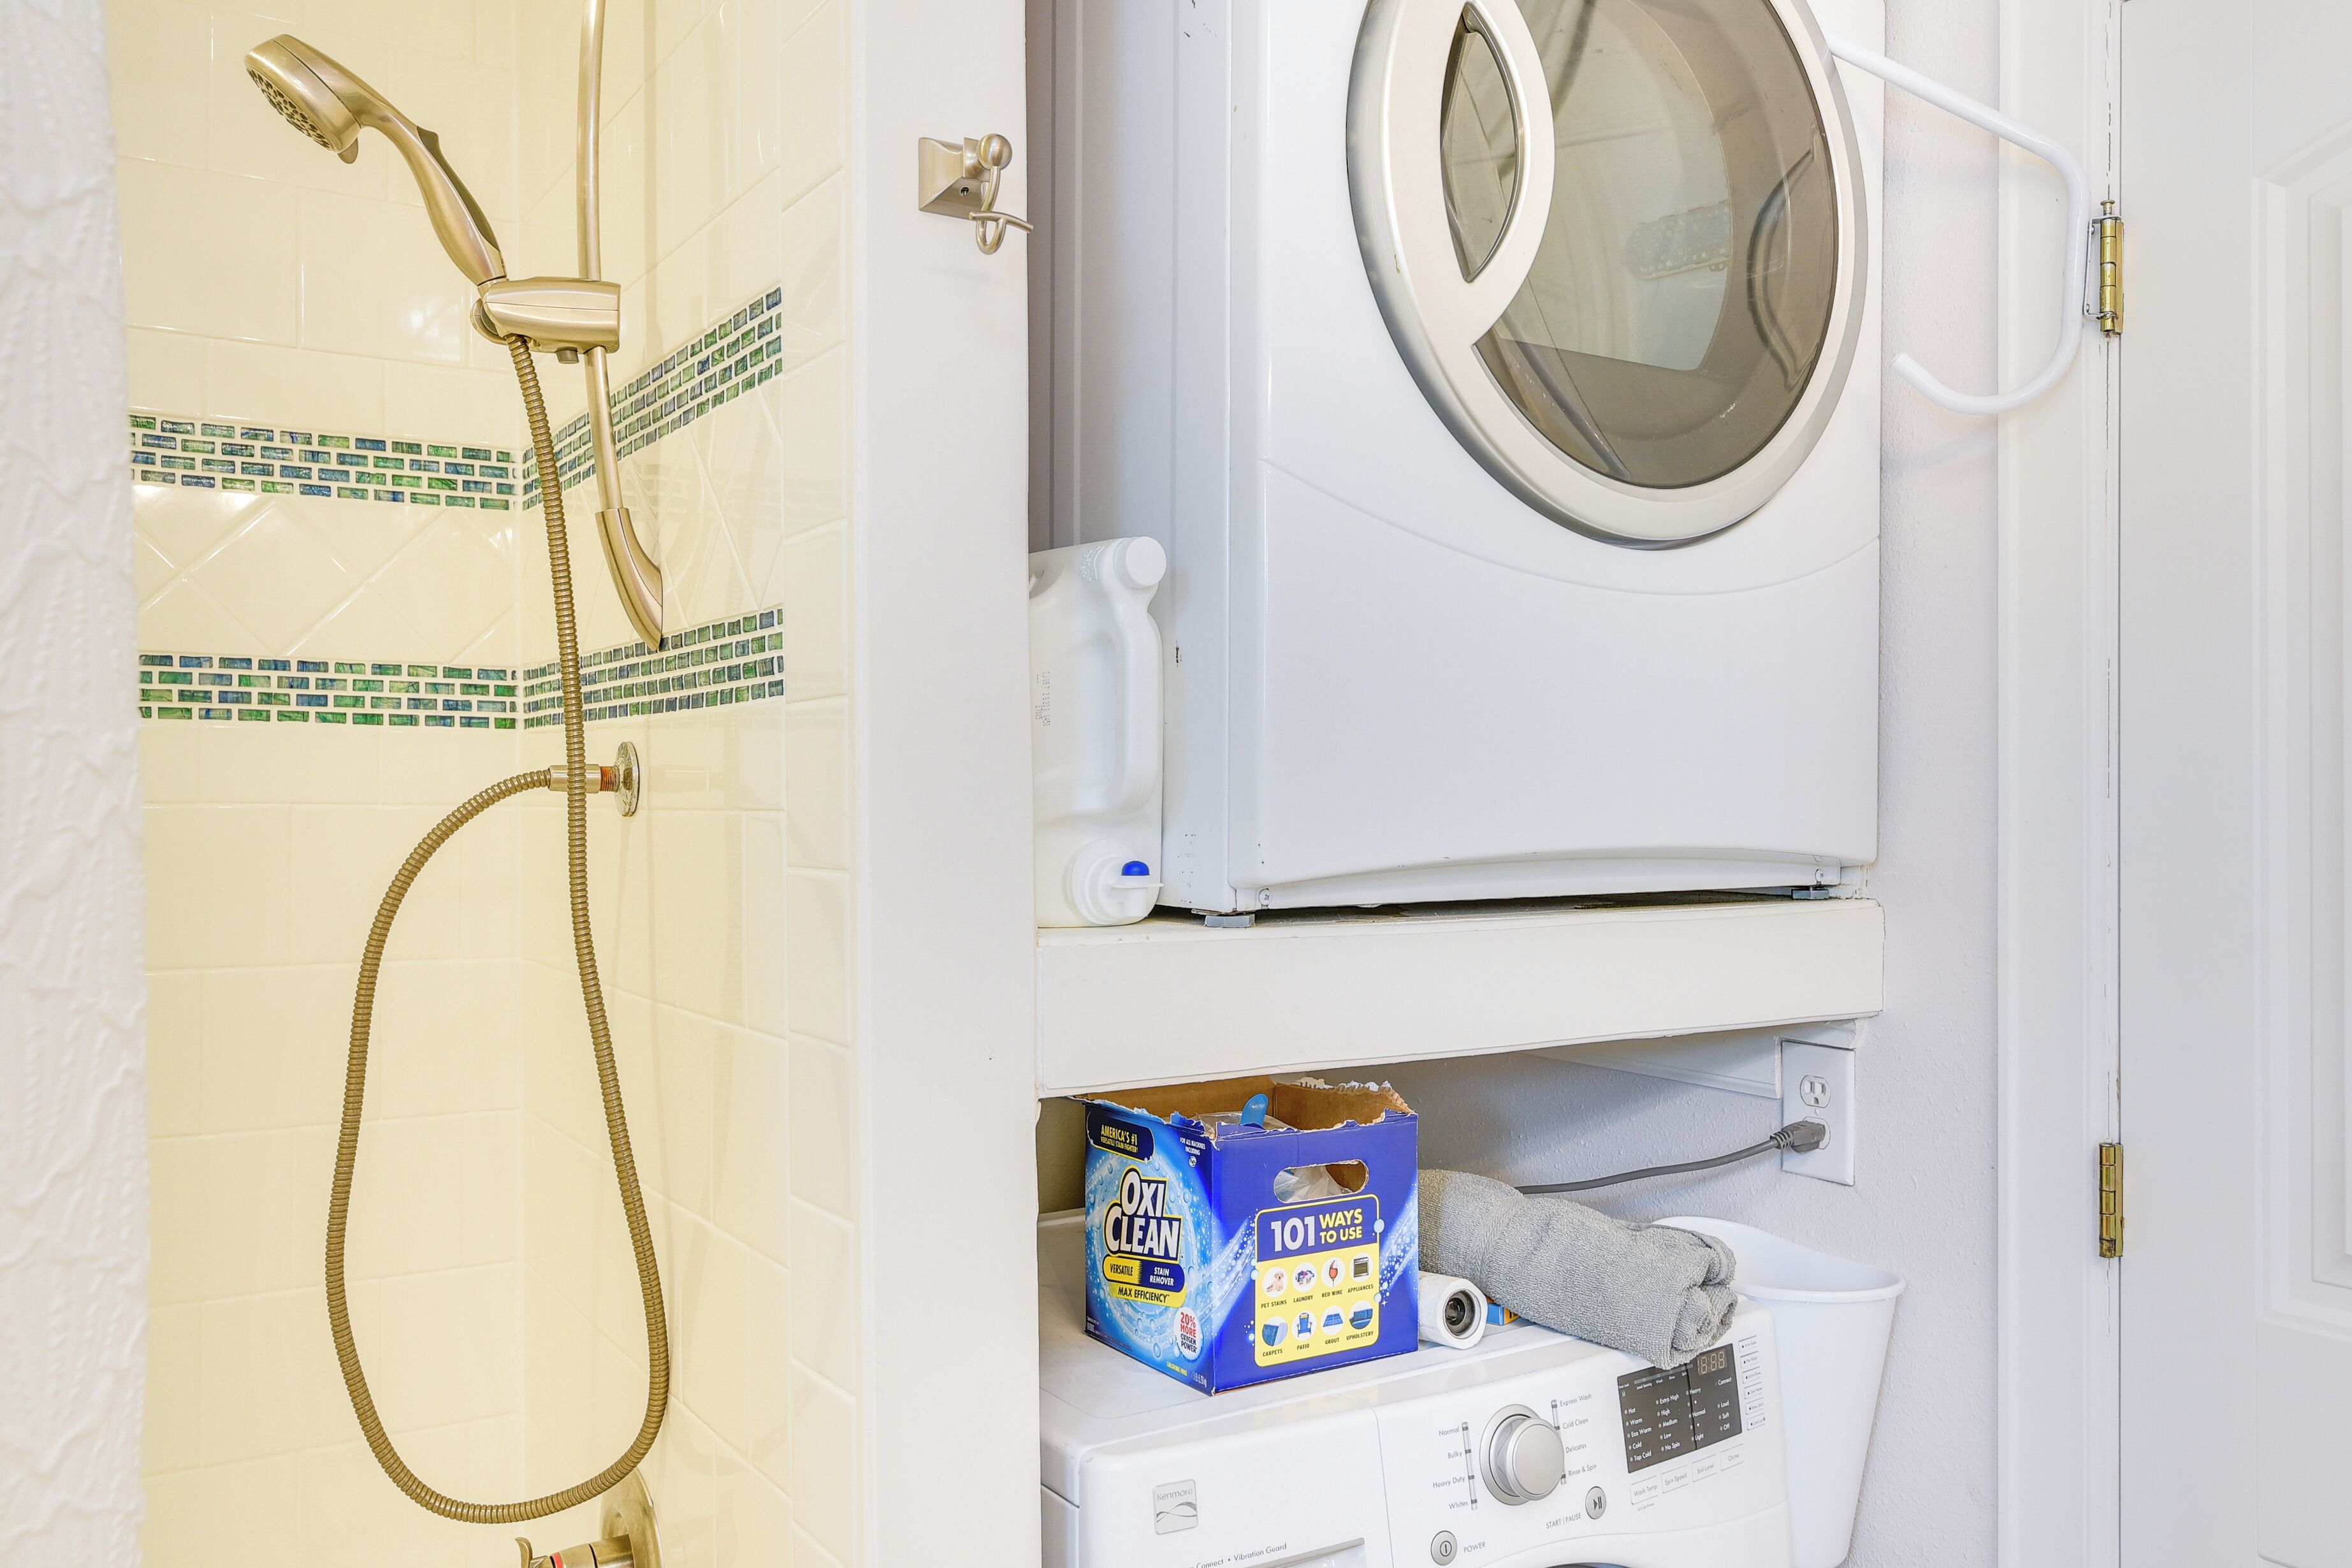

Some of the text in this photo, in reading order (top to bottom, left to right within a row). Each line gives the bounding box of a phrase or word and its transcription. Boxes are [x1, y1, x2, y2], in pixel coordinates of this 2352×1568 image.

[1101, 1124, 1138, 1146] AMERICA'S #1
[1101, 1136, 1115, 1147] VERSATILE
[1115, 1141, 1124, 1149] STAIN
[1191, 1140, 1205, 1149] MACHINES
[1186, 1146, 1200, 1156] INCLUDING
[1121, 1172, 1165, 1217] OXI
[1319, 1209, 1363, 1229] WAYS
[1105, 1205, 1179, 1258] CLEAN
[1271, 1216, 1315, 1252] 101
[1319, 1226, 1362, 1244] TO USE
[1110, 1263, 1133, 1277] VERSATILE
[1154, 1267, 1170, 1277] STAIN
[1149, 1276, 1174, 1286] REMOVER
[1118, 1286, 1133, 1298] MAX
[1347, 1284, 1374, 1293] APPLIANCES
[1271, 1299, 1288, 1307] STAINS
[1293, 1295, 1314, 1303] LAUNDRY
[1180, 1312, 1196, 1328] 20%
[1180, 1324, 1196, 1338] MORE
[1346, 1331, 1374, 1341] UPHOLSTERY
[1180, 1333, 1196, 1346] OXYGEN
[1262, 1348, 1283, 1357] CARPETS
[1718, 1377, 1732, 1386] Connect
[1560, 1393, 1592, 1407] Express Wash
[1670, 1393, 1680, 1401] High
[1720, 1400, 1730, 1408] Loud
[1660, 1408, 1671, 1416] High
[1692, 1407, 1706, 1418] Normal
[1562, 1418, 1589, 1430] Cold Clean
[1662, 1419, 1678, 1428] Medium
[1439, 1426, 1460, 1436] Normal
[1694, 1433, 1704, 1441] Light
[1565, 1443, 1587, 1453] Delicates
[1632, 1441, 1642, 1449] Cold
[1671, 1441, 1681, 1449] Spin
[1448, 1450, 1462, 1459] Bulky
[1642, 1450, 1652, 1458] Cold
[1728, 1453, 1740, 1462] Chime
[1568, 1469, 1581, 1477] Rinse
[1586, 1463, 1597, 1473] Spin
[1704, 1463, 1715, 1472] Level
[1433, 1476, 1465, 1490] Heavy Duty
[1664, 1472, 1687, 1486] Spin Speed
[1157, 1488, 1193, 1501] Kenmore
[1634, 1485, 1658, 1497] Wash Temp
[1448, 1500, 1469, 1510] Whites
[1233, 1550, 1264, 1561] Vibration
[1265, 1543, 1287, 1554] Guard
[1463, 1541, 1486, 1553] POWER
